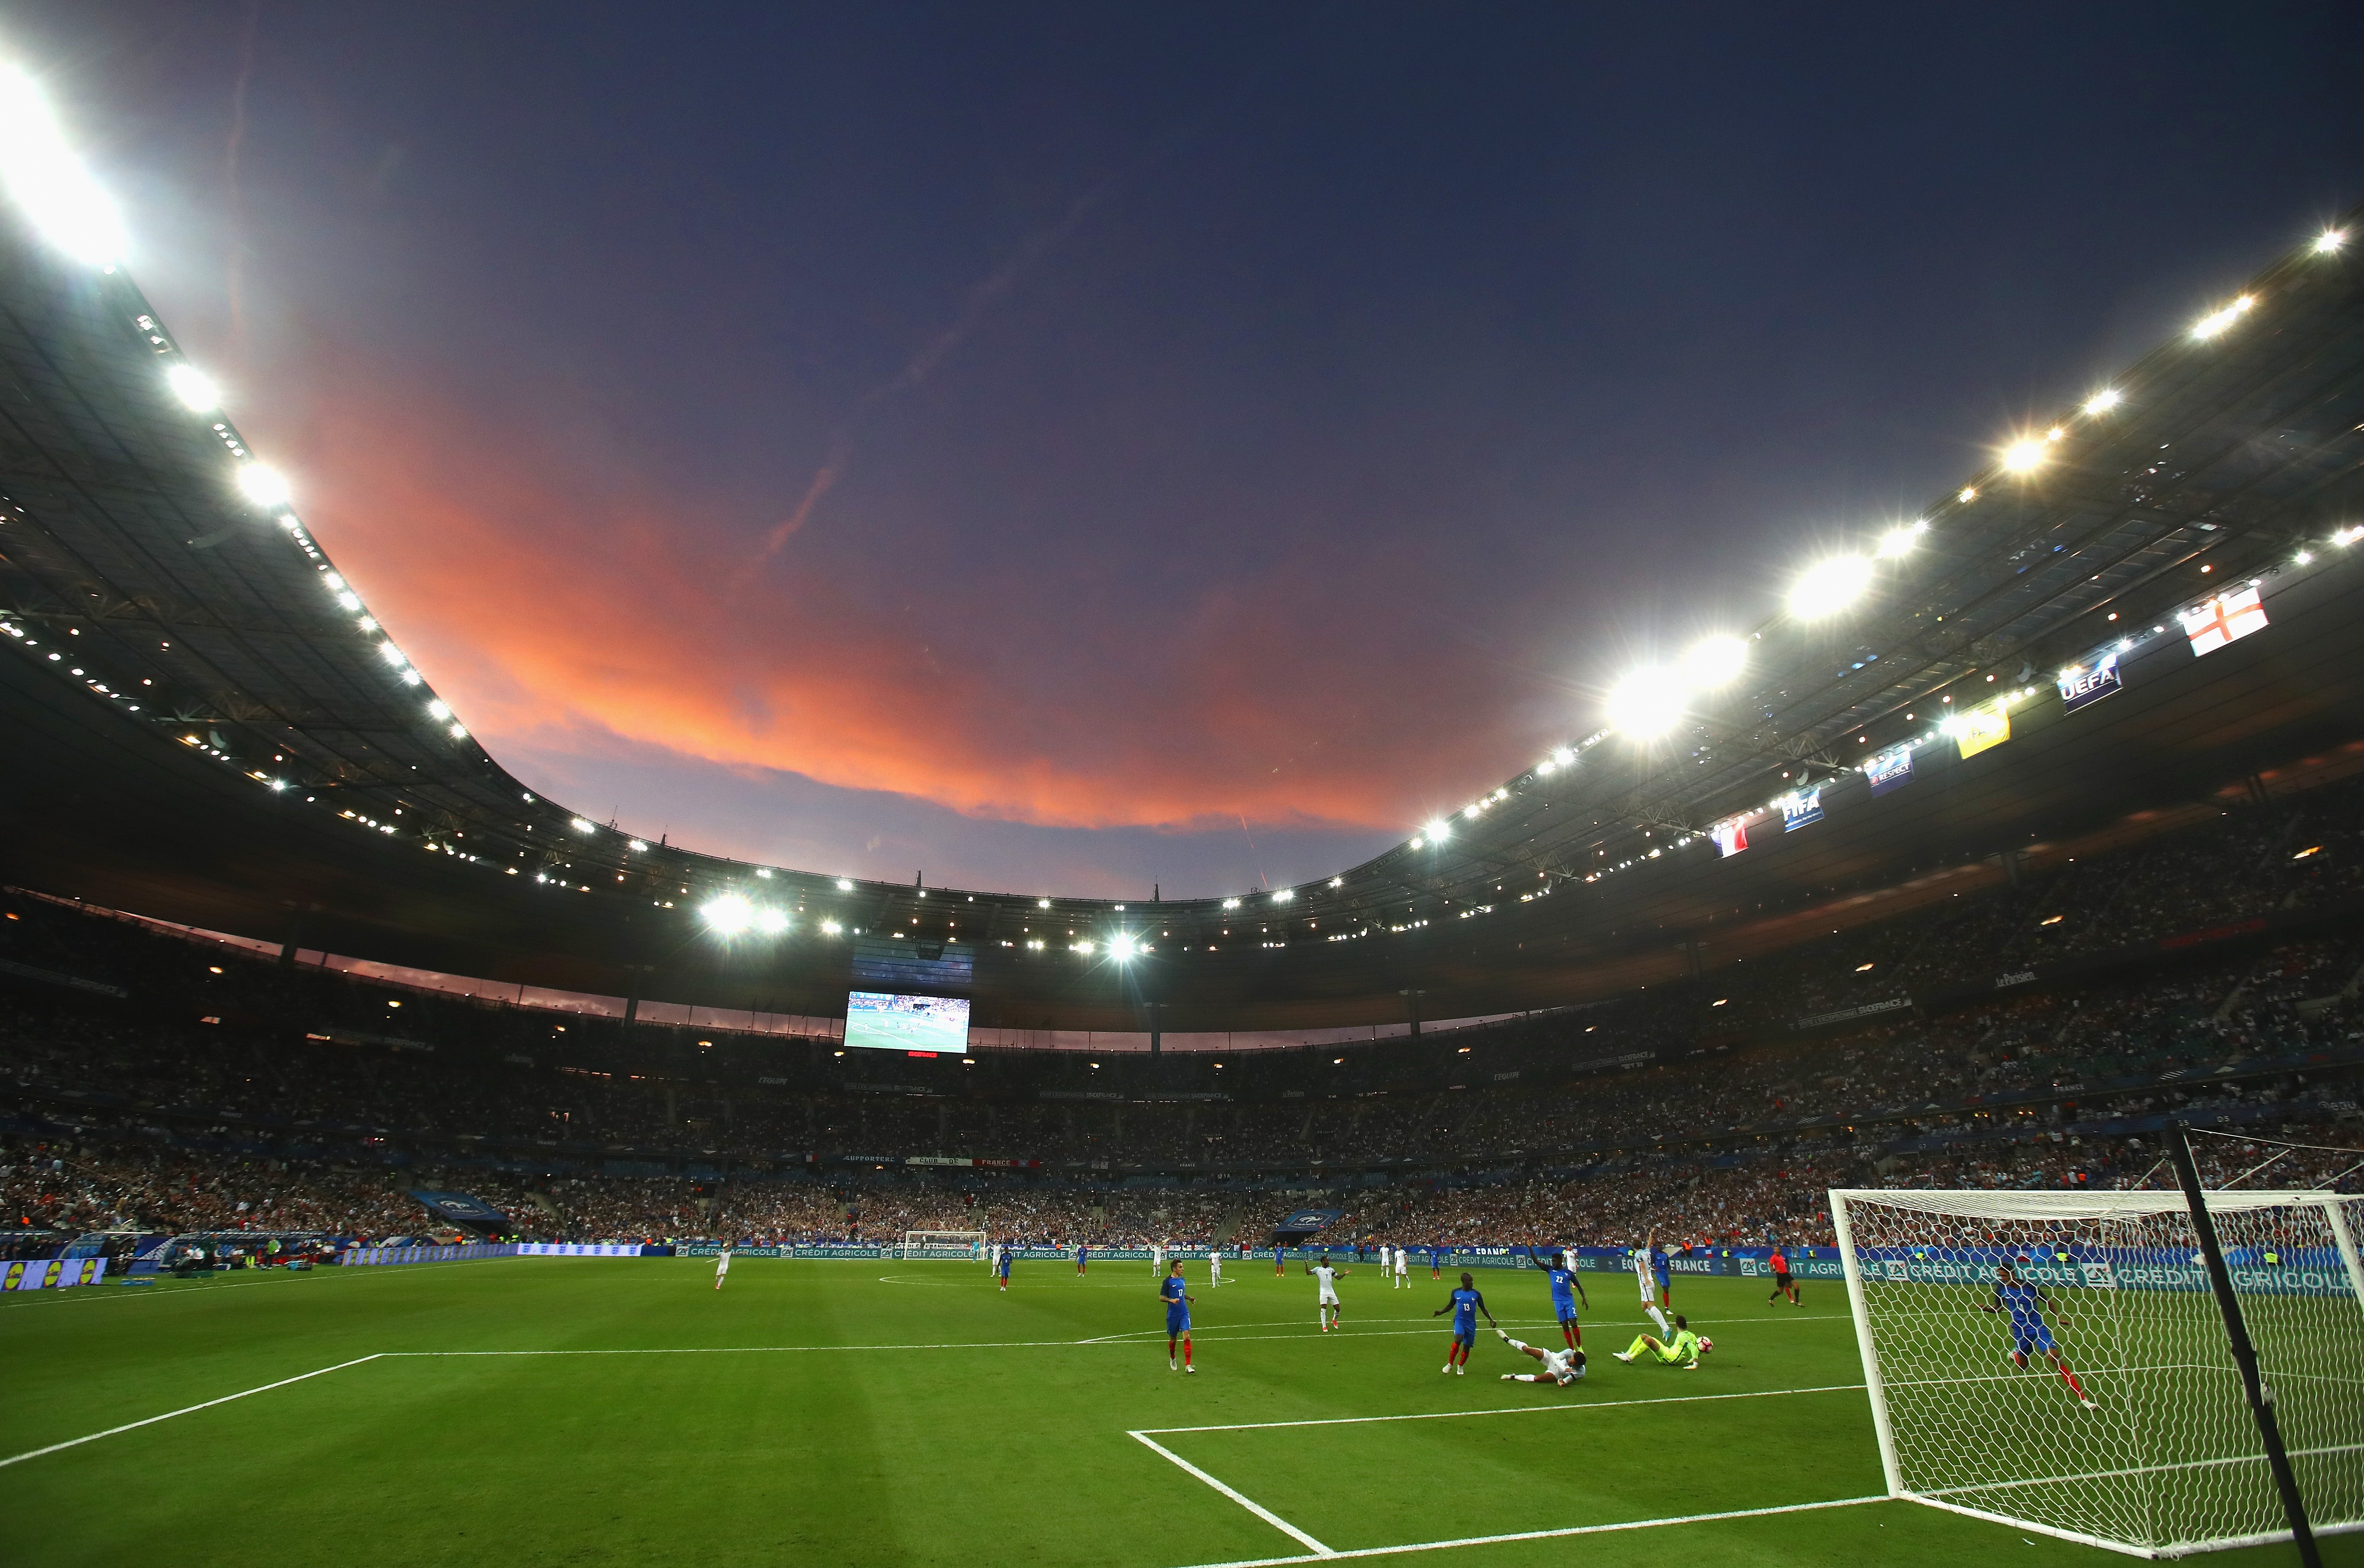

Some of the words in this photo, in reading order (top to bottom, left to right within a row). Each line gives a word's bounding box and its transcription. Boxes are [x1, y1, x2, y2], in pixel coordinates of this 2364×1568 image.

[2060, 669, 2115, 700] UEFA
[1878, 763, 1910, 781] RESPECT
[1784, 794, 1820, 822] FIFA
[795, 1248, 829, 1256] CRÉDIT
[1458, 1256, 1480, 1264] CRÉDIT
[1482, 1257, 1515, 1266] AGRICOLE
[1669, 1260, 1711, 1272] FRANCE
[2233, 1271, 2354, 1289] GRICOLE
[1463, 1303, 1470, 1311] 13
